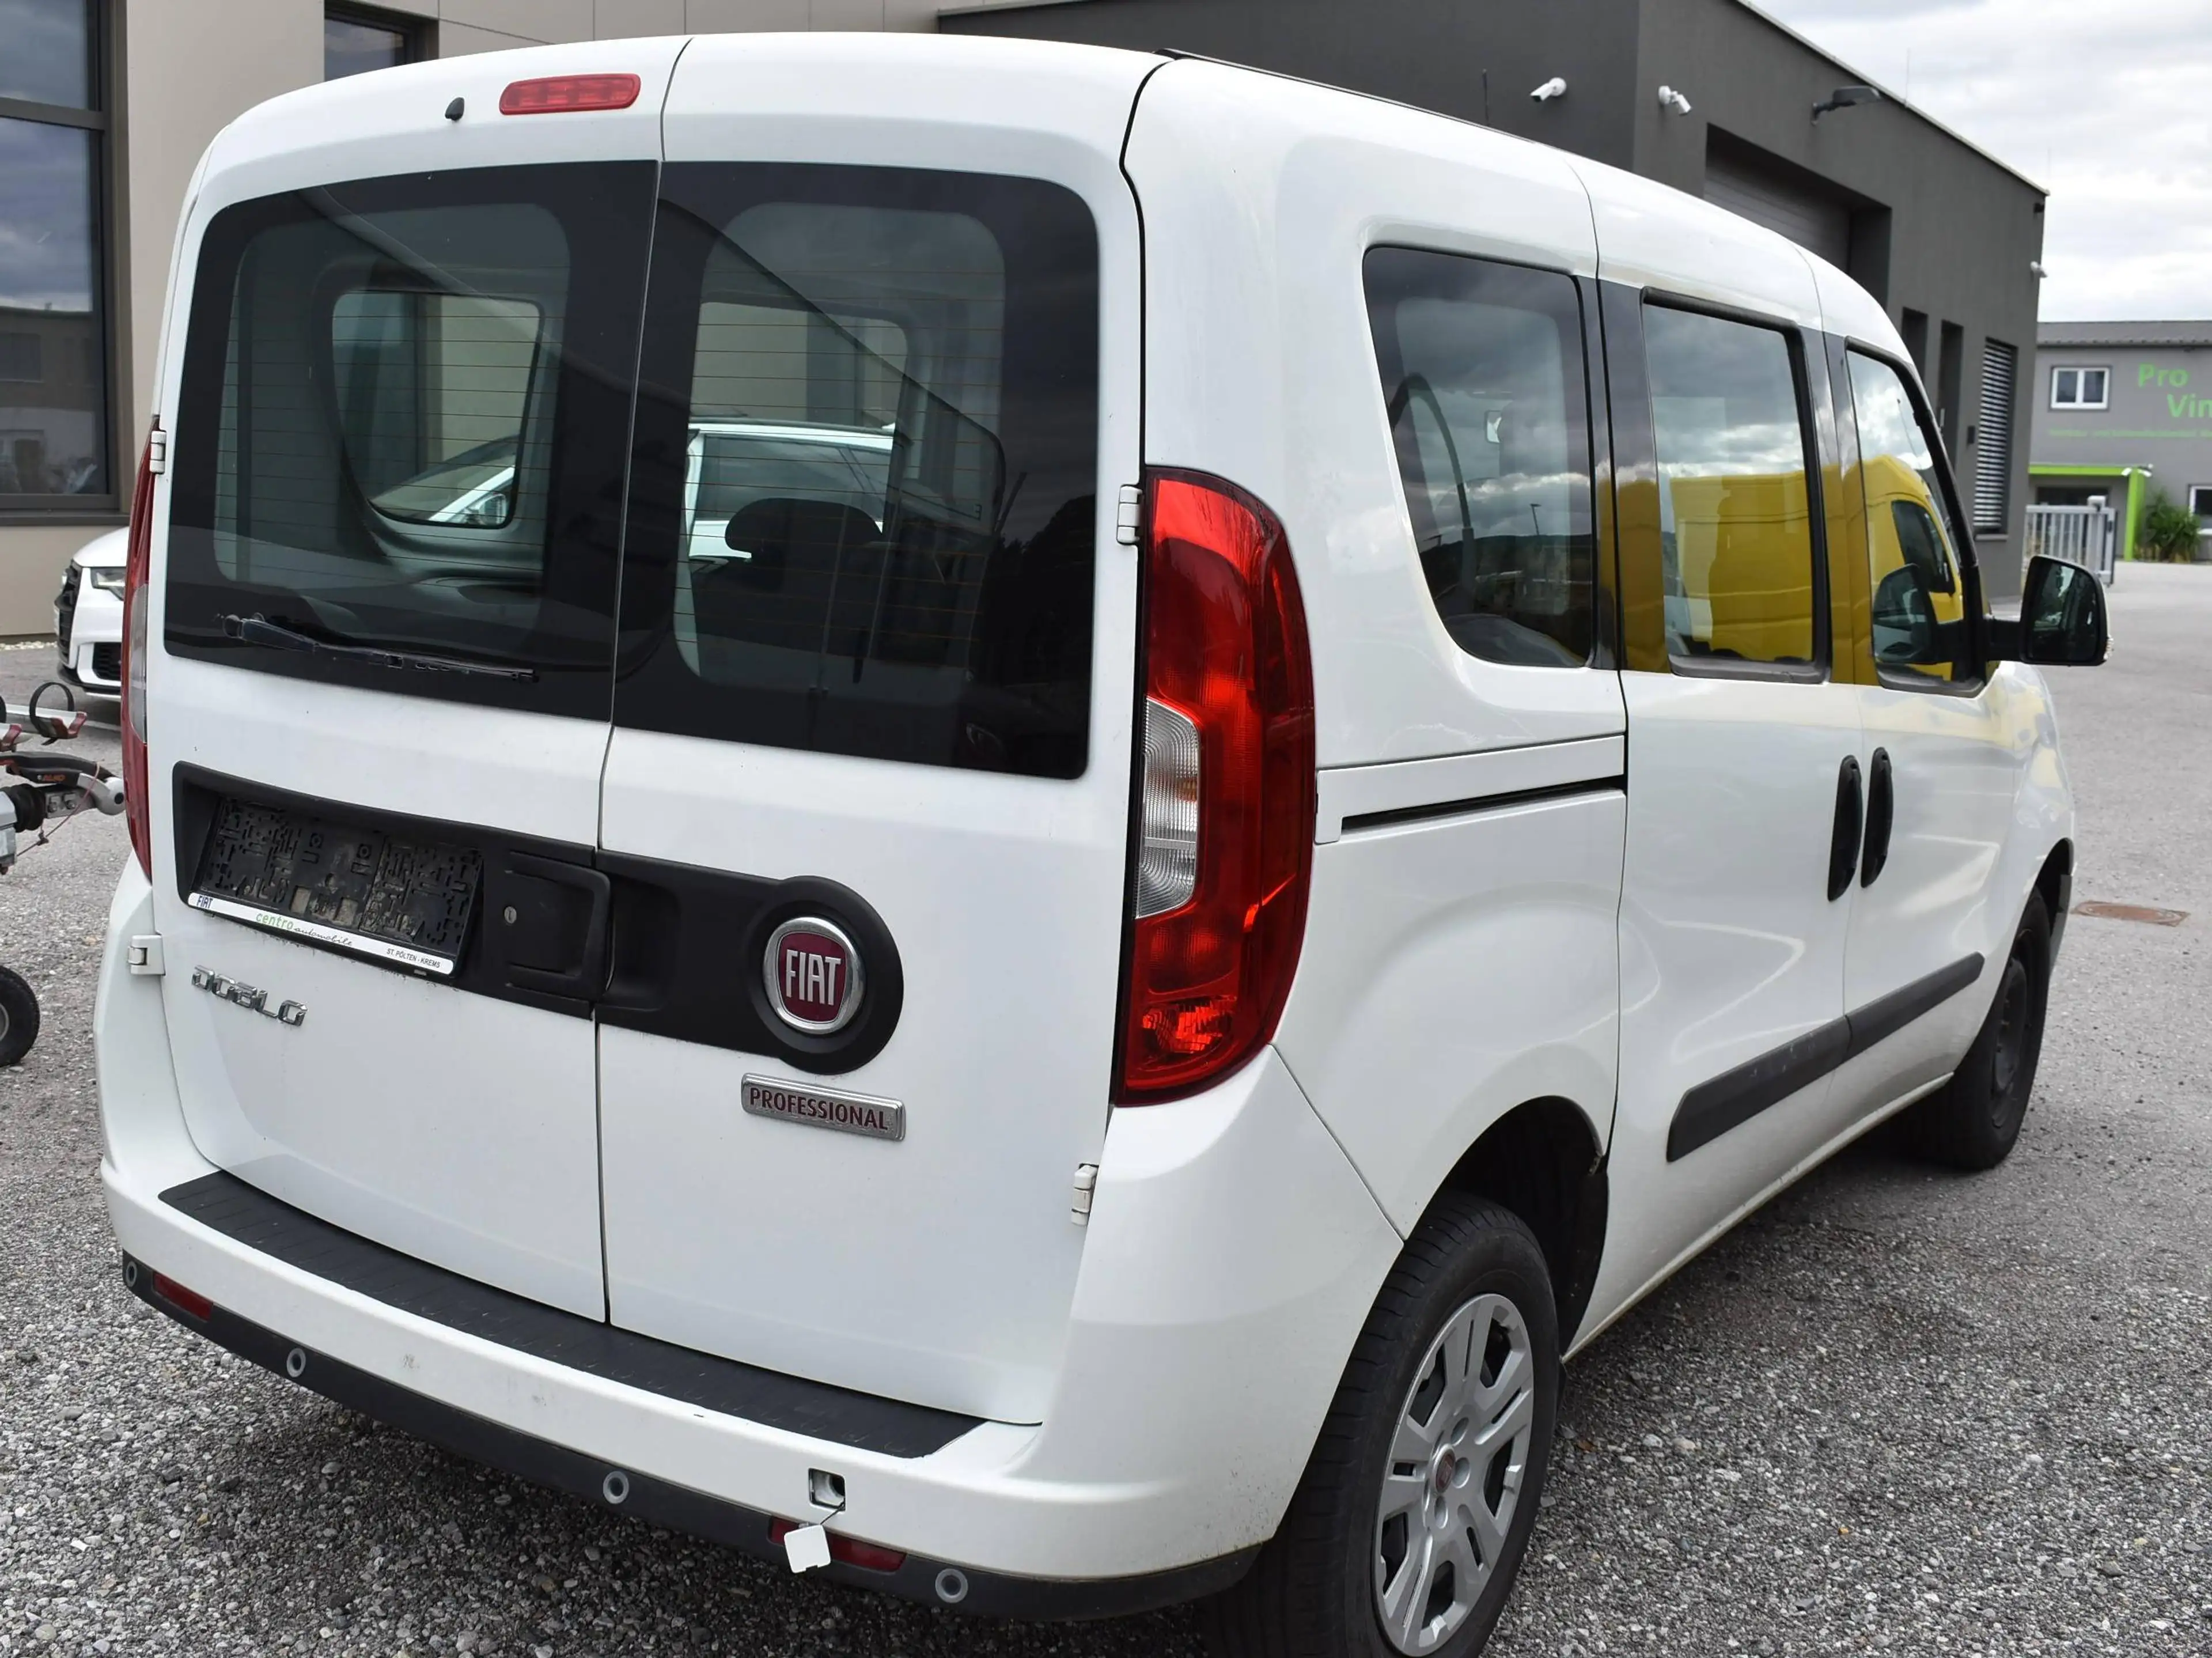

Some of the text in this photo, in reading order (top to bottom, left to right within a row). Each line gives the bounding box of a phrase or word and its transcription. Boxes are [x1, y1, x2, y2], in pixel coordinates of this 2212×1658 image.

[2138, 364, 2189, 388] Pro
[196, 895, 213, 909] FIAT
[256, 911, 294, 930] centro
[294, 928, 353, 946] automobile
[395, 950, 418, 962] PÖLTEN
[420, 957, 441, 968] KREMS
[785, 948, 842, 1006] FIAT
[191, 964, 308, 1027] DOBLO
[750, 1087, 888, 1131] PROFESSIONAL
